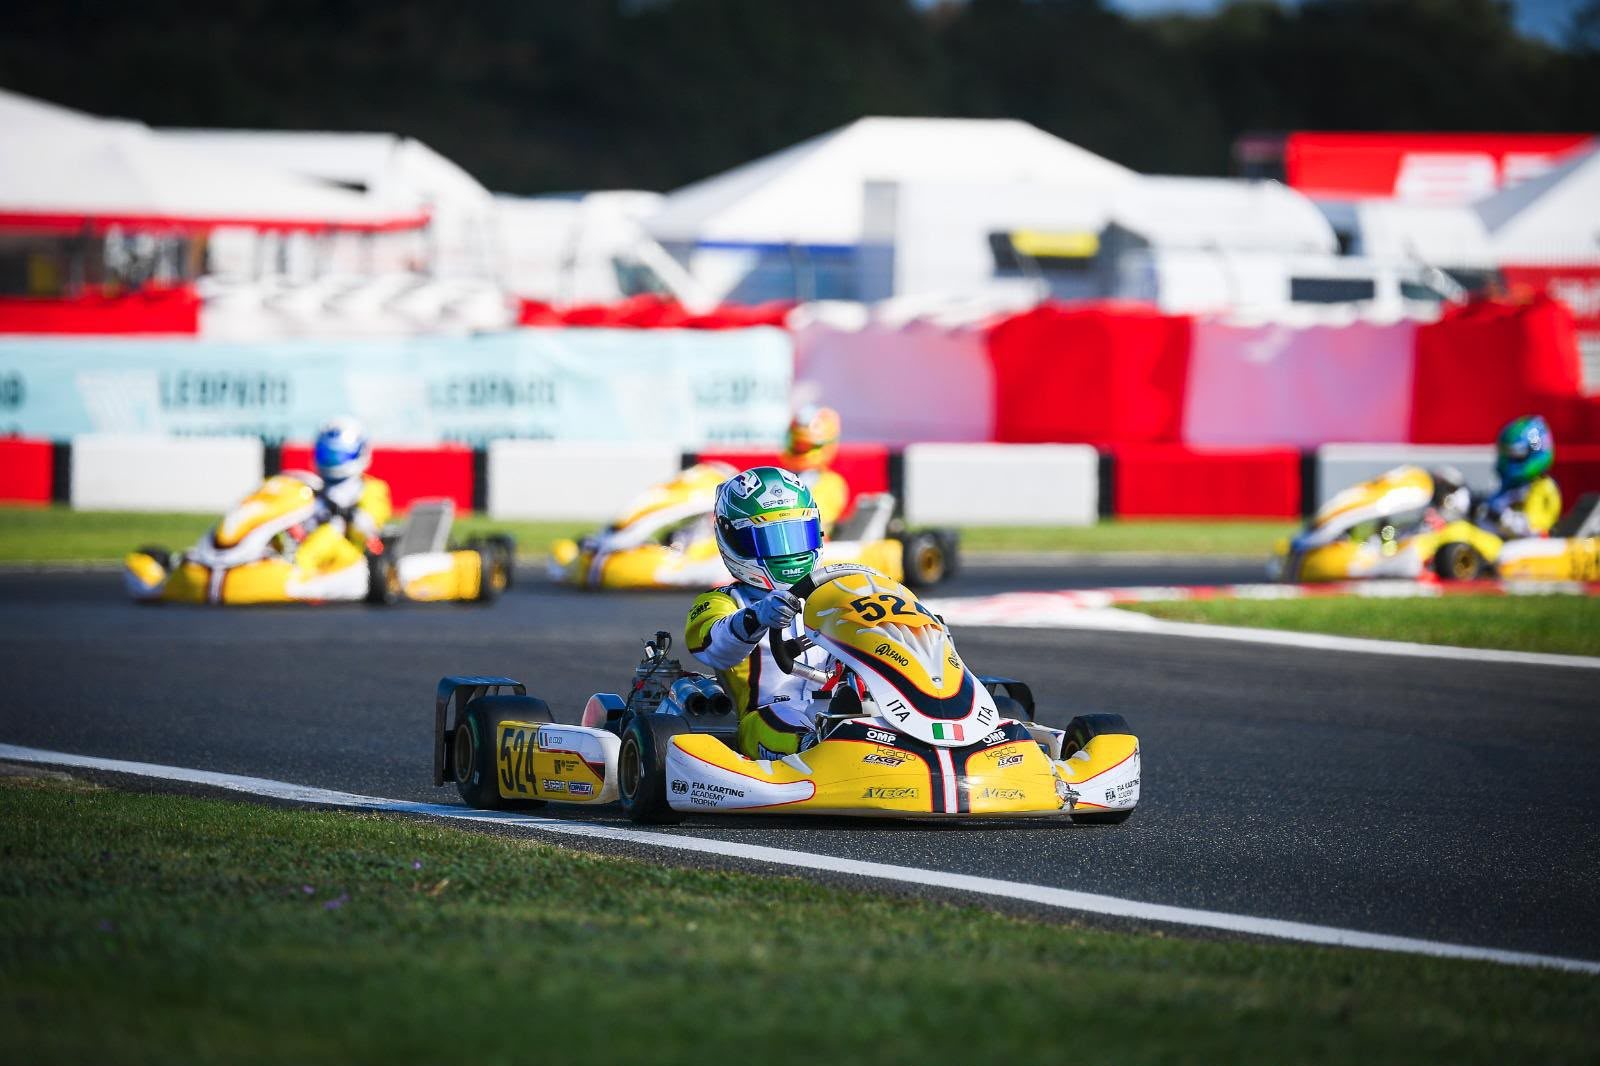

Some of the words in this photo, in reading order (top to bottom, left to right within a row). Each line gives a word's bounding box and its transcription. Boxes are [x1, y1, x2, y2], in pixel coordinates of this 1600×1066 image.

[850, 594, 940, 625] 524
[887, 699, 911, 723] ITA
[976, 705, 994, 726] ITA
[866, 729, 897, 744] OMP
[982, 729, 1006, 744] OMP
[500, 727, 538, 796] 524
[691, 790, 725, 801] ACADEMY
[692, 782, 705, 790] FIA
[707, 784, 745, 798] KARTING
[863, 787, 919, 799] VEGA
[690, 797, 718, 807] TROPHY
